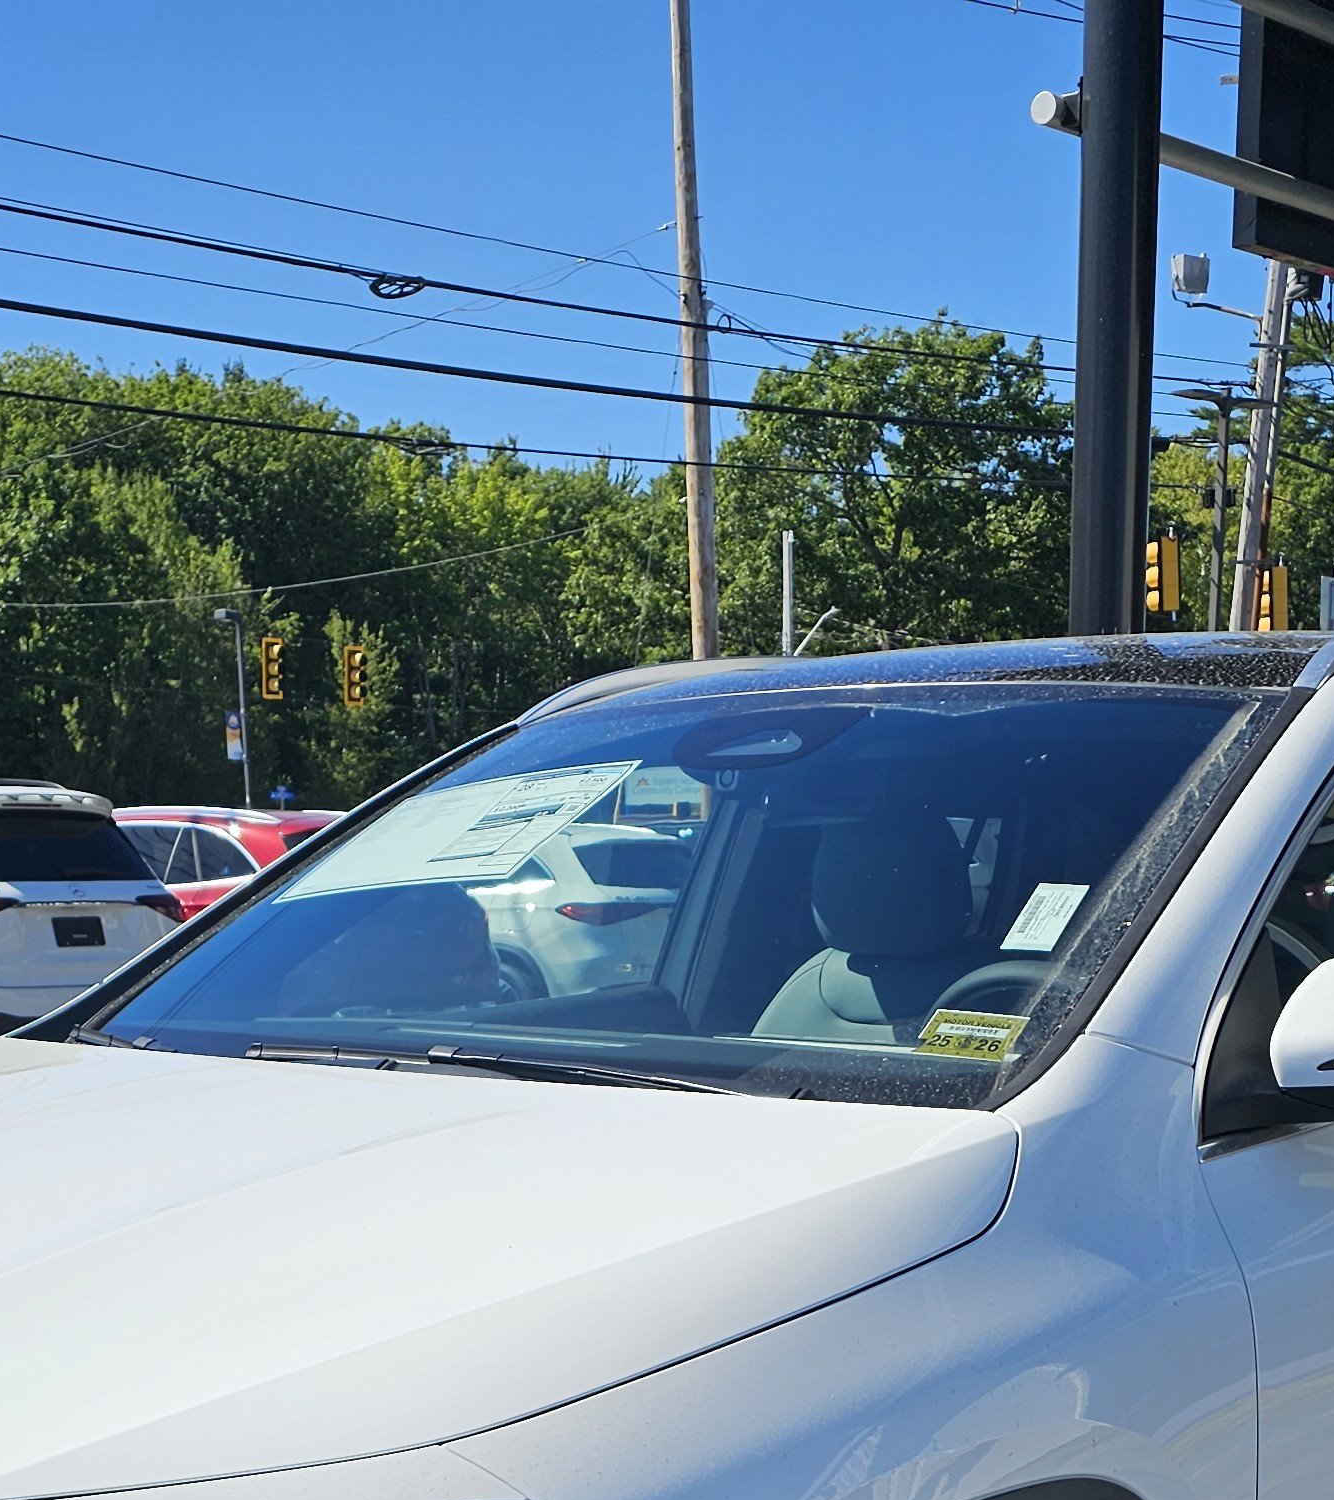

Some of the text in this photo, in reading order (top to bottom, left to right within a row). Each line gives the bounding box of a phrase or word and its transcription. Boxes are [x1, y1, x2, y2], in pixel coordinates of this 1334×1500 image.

[943, 1018, 1012, 1029] MOTOR VEHICLE
[926, 1034, 1002, 1052] 25 26
